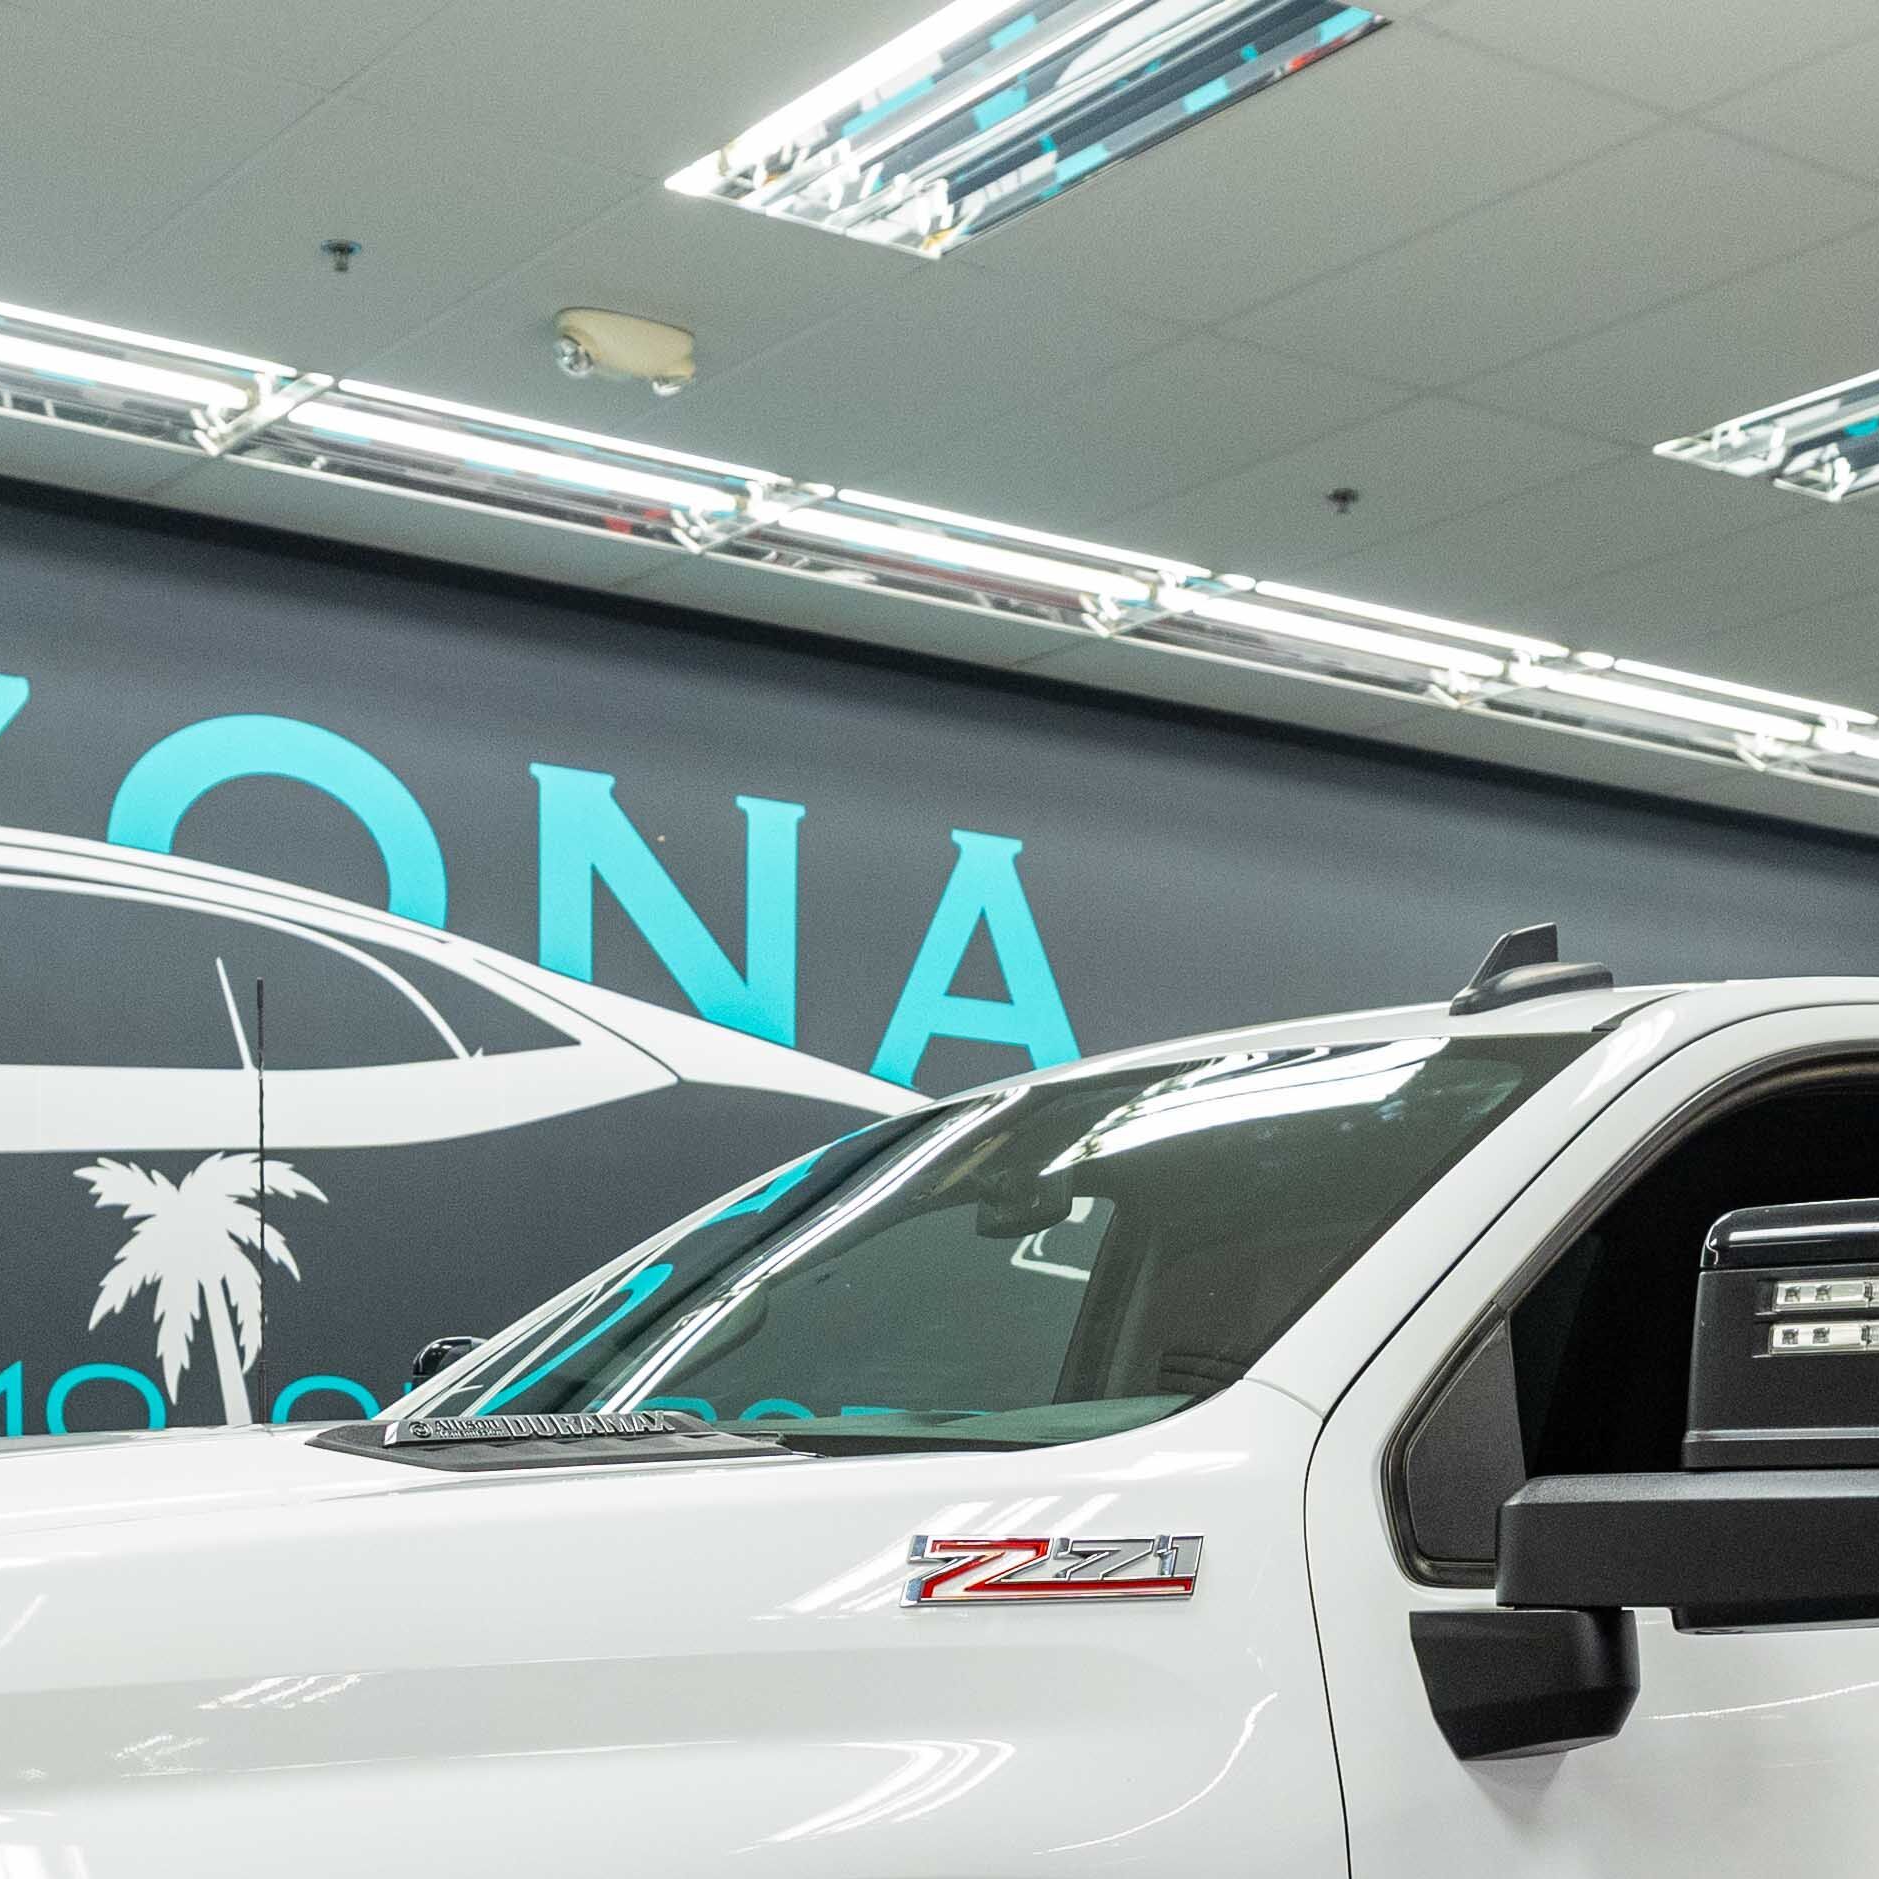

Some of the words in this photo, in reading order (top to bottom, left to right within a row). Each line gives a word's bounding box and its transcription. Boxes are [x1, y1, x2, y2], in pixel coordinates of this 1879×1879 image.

[434, 1419, 501, 1432] Allison
[505, 1410, 676, 1438] DURAMAX
[899, 1534, 1205, 1608] Z71
